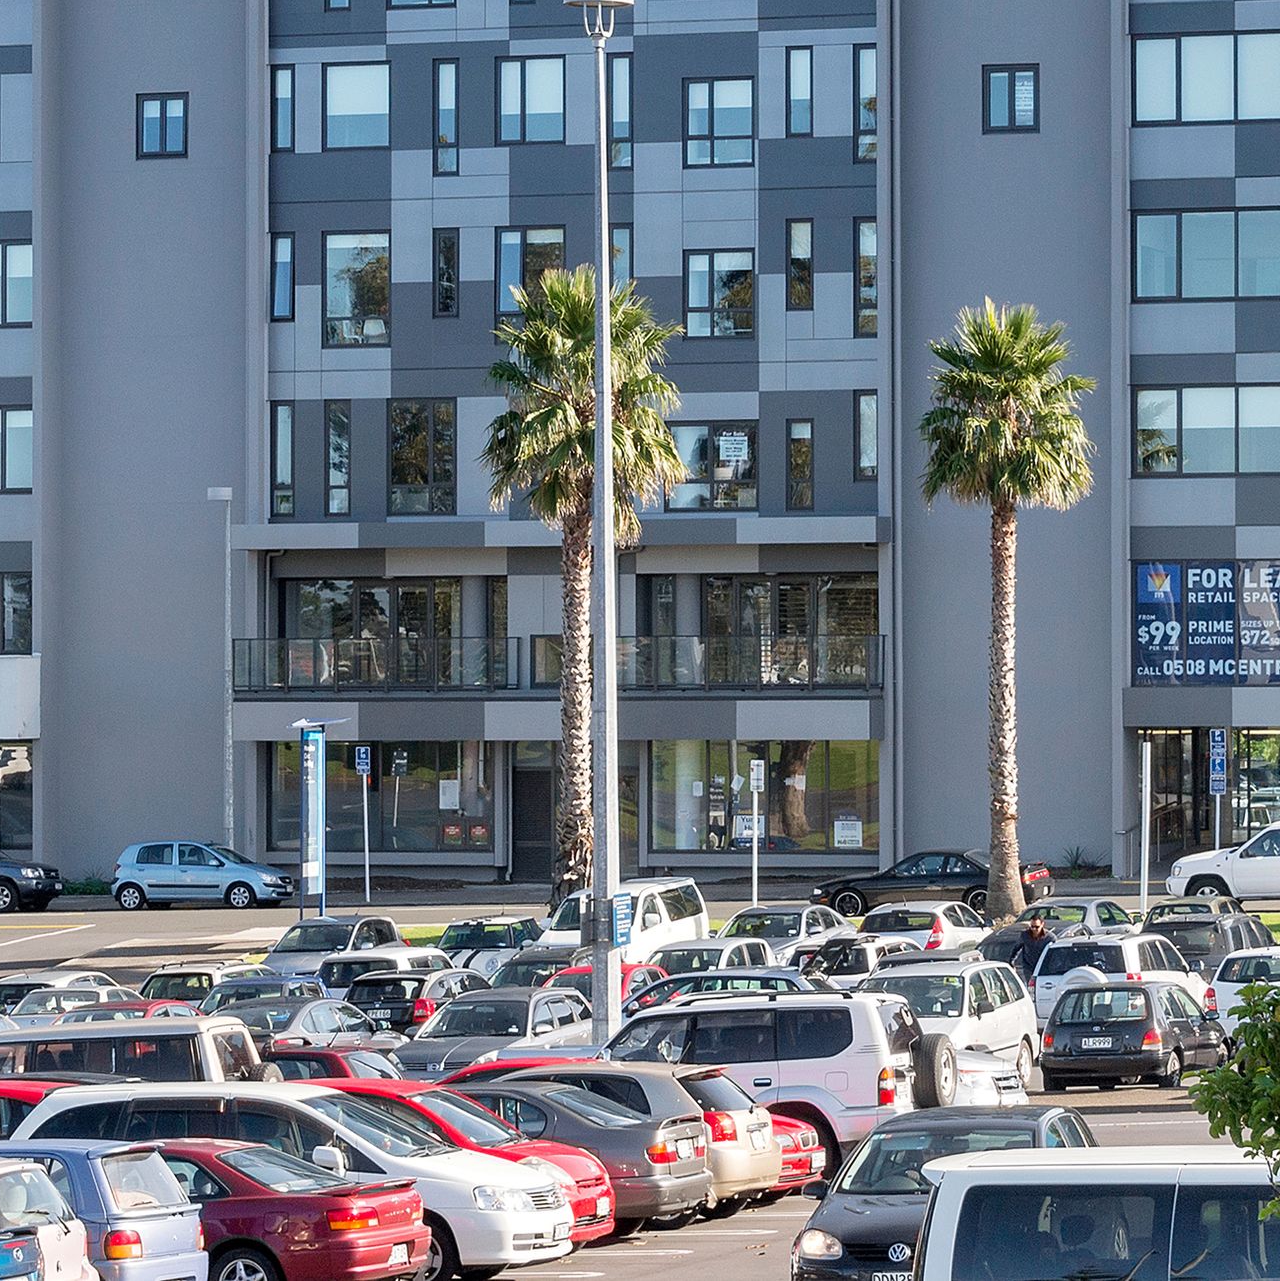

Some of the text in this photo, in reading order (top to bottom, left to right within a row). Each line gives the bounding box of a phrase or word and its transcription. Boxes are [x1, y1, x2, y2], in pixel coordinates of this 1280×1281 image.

[1187, 568, 1233, 588] FOR
[1189, 592, 1235, 603] RETAIL
[1189, 621, 1233, 633] PRIME
[1264, 620, 1274, 628] UP
[1137, 621, 1181, 644] $99
[1241, 630, 1270, 645] 372
[1189, 636, 1234, 644] LOCATION
[1137, 667, 1162, 675] CALL
[1163, 660, 1205, 676] 0508
